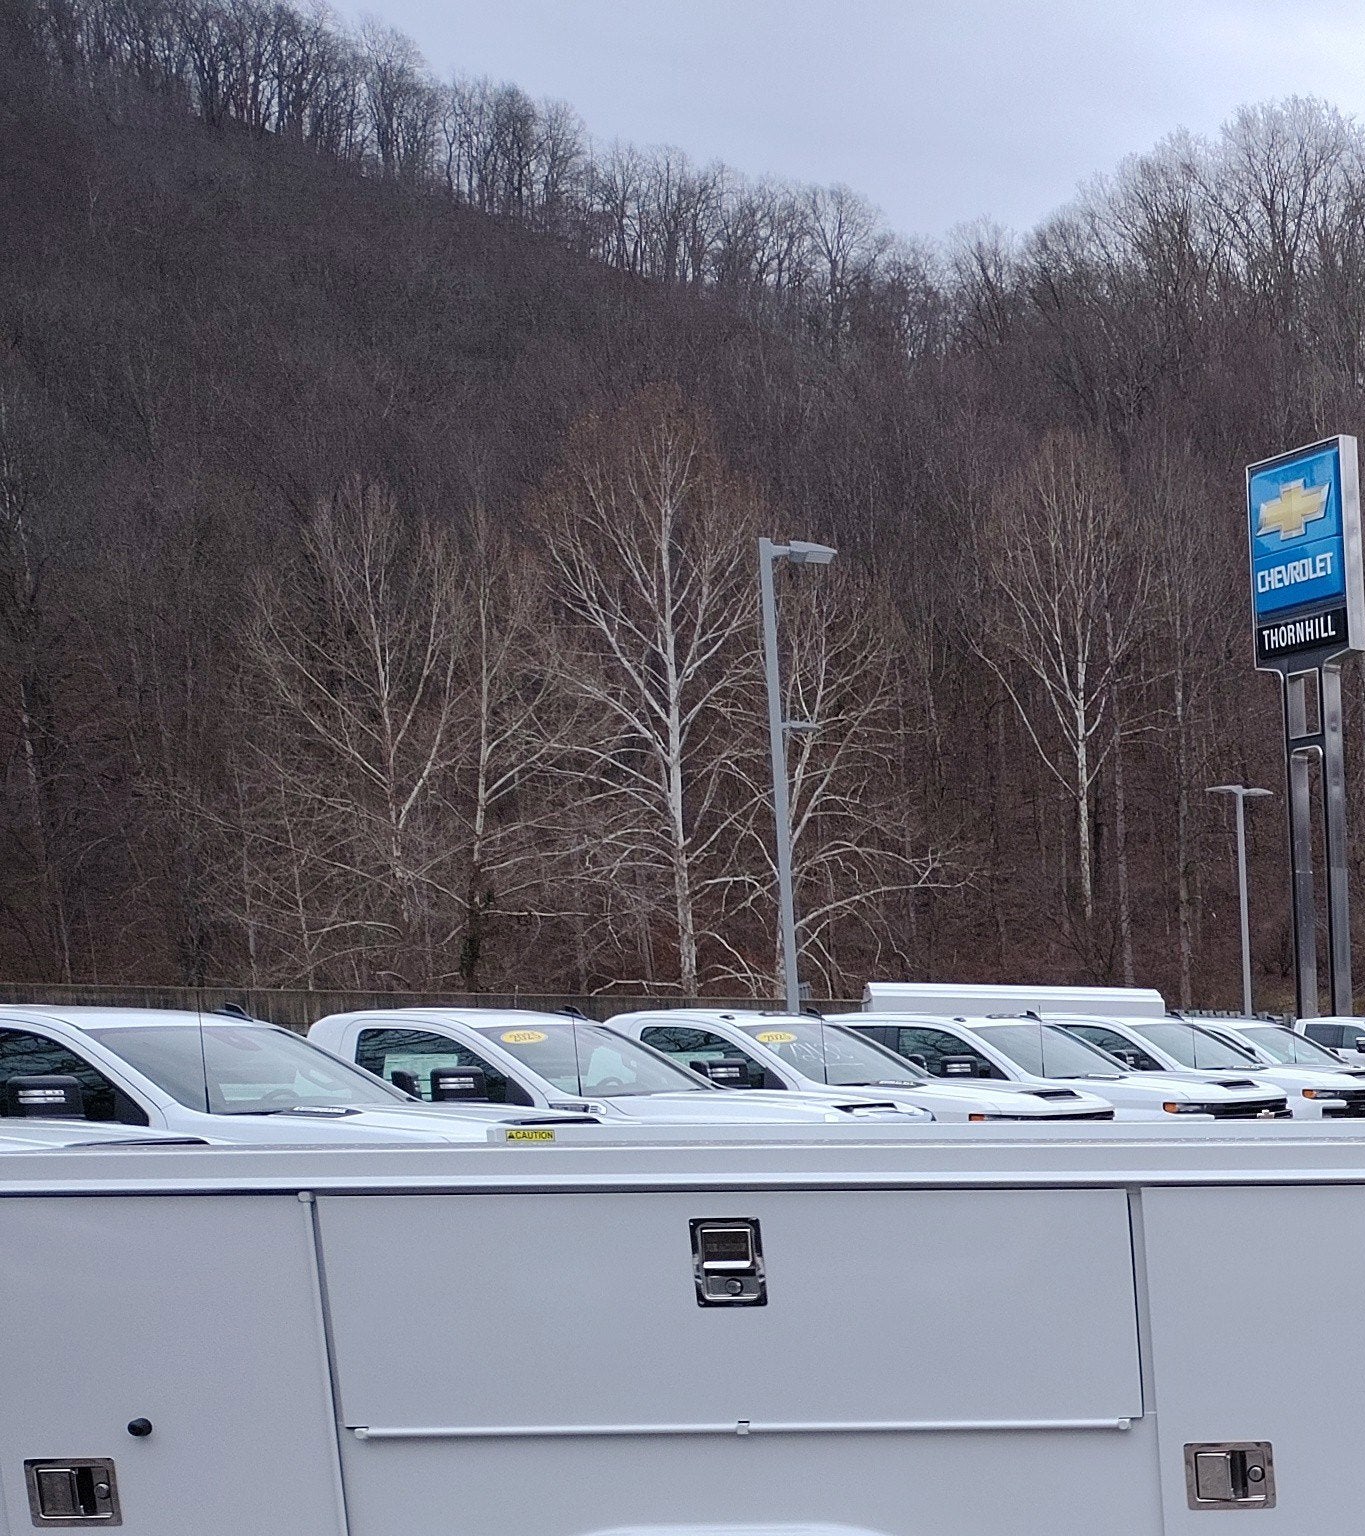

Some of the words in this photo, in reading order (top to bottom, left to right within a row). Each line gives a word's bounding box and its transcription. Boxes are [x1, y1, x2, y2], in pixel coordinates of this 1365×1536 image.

[1257, 552, 1333, 593] CHEVROLET
[1262, 614, 1336, 650] THORNHILL
[515, 1131, 553, 1140] CAUTION
